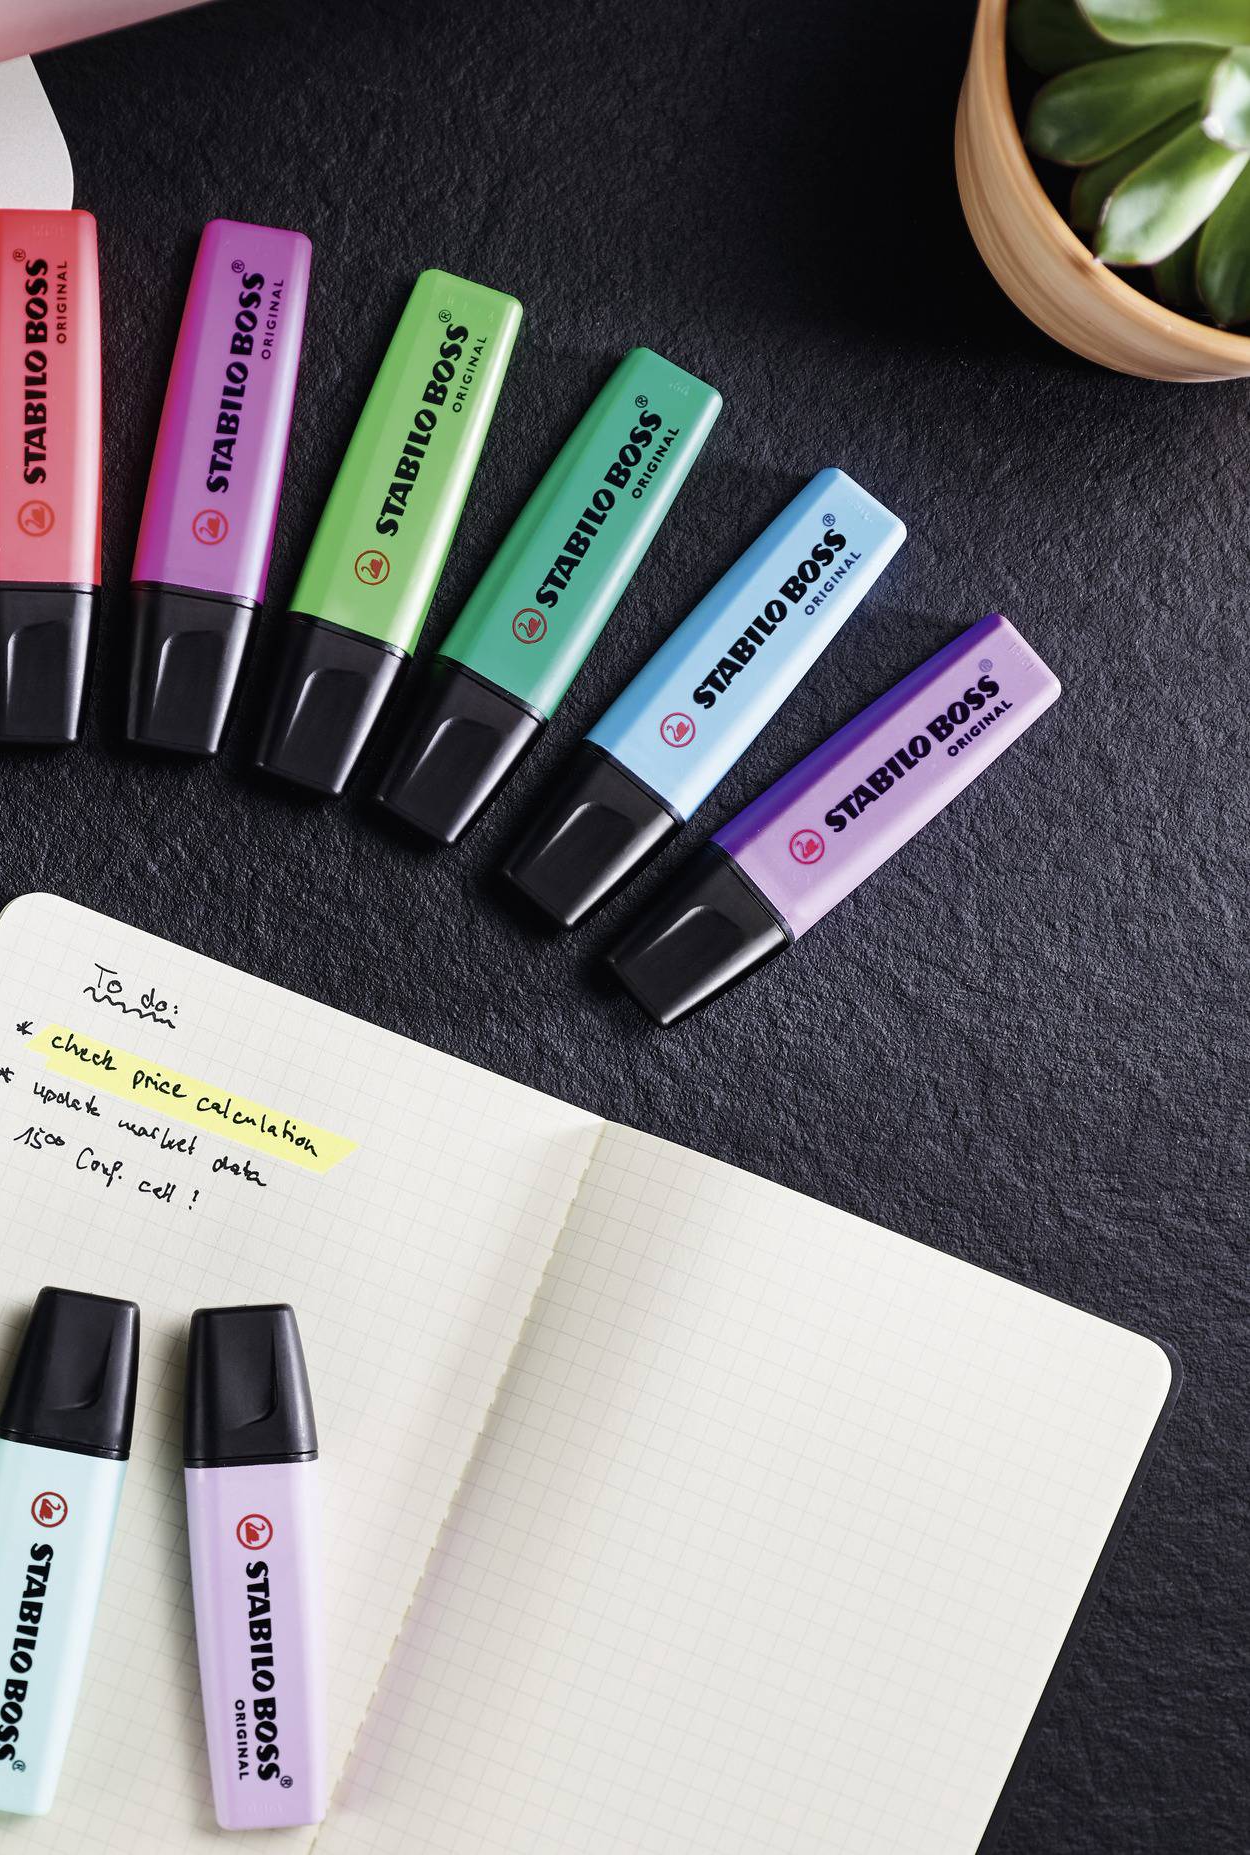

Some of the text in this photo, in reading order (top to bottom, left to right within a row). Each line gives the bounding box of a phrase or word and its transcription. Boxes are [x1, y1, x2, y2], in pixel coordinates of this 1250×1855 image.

[56, 261, 68, 344] ORIGINAL
[261, 279, 285, 361] ORIGINAL
[23, 350, 48, 484] STABILO
[452, 336, 487, 413] ORIGINAL
[206, 362, 248, 493] STABILO
[376, 409, 437, 537] STABILO
[632, 428, 680, 499] ORIGINAL
[536, 489, 615, 608] STABILO
[805, 550, 862, 616] ORIGINAL
[693, 604, 788, 709] STABILO
[947, 699, 1013, 757] ORIGINAL
[825, 735, 931, 832] STABILO
[94, 963, 178, 1014] To do:
[33, 1082, 267, 1187] update market data
[51, 1034, 318, 1157] check price calculation
[76, 1147, 123, 1187] Conf.
[10, 1543, 54, 1673] STABILO
[246, 1561, 275, 1692] STABILO
[235, 1699, 249, 1781] ORIGINAL
